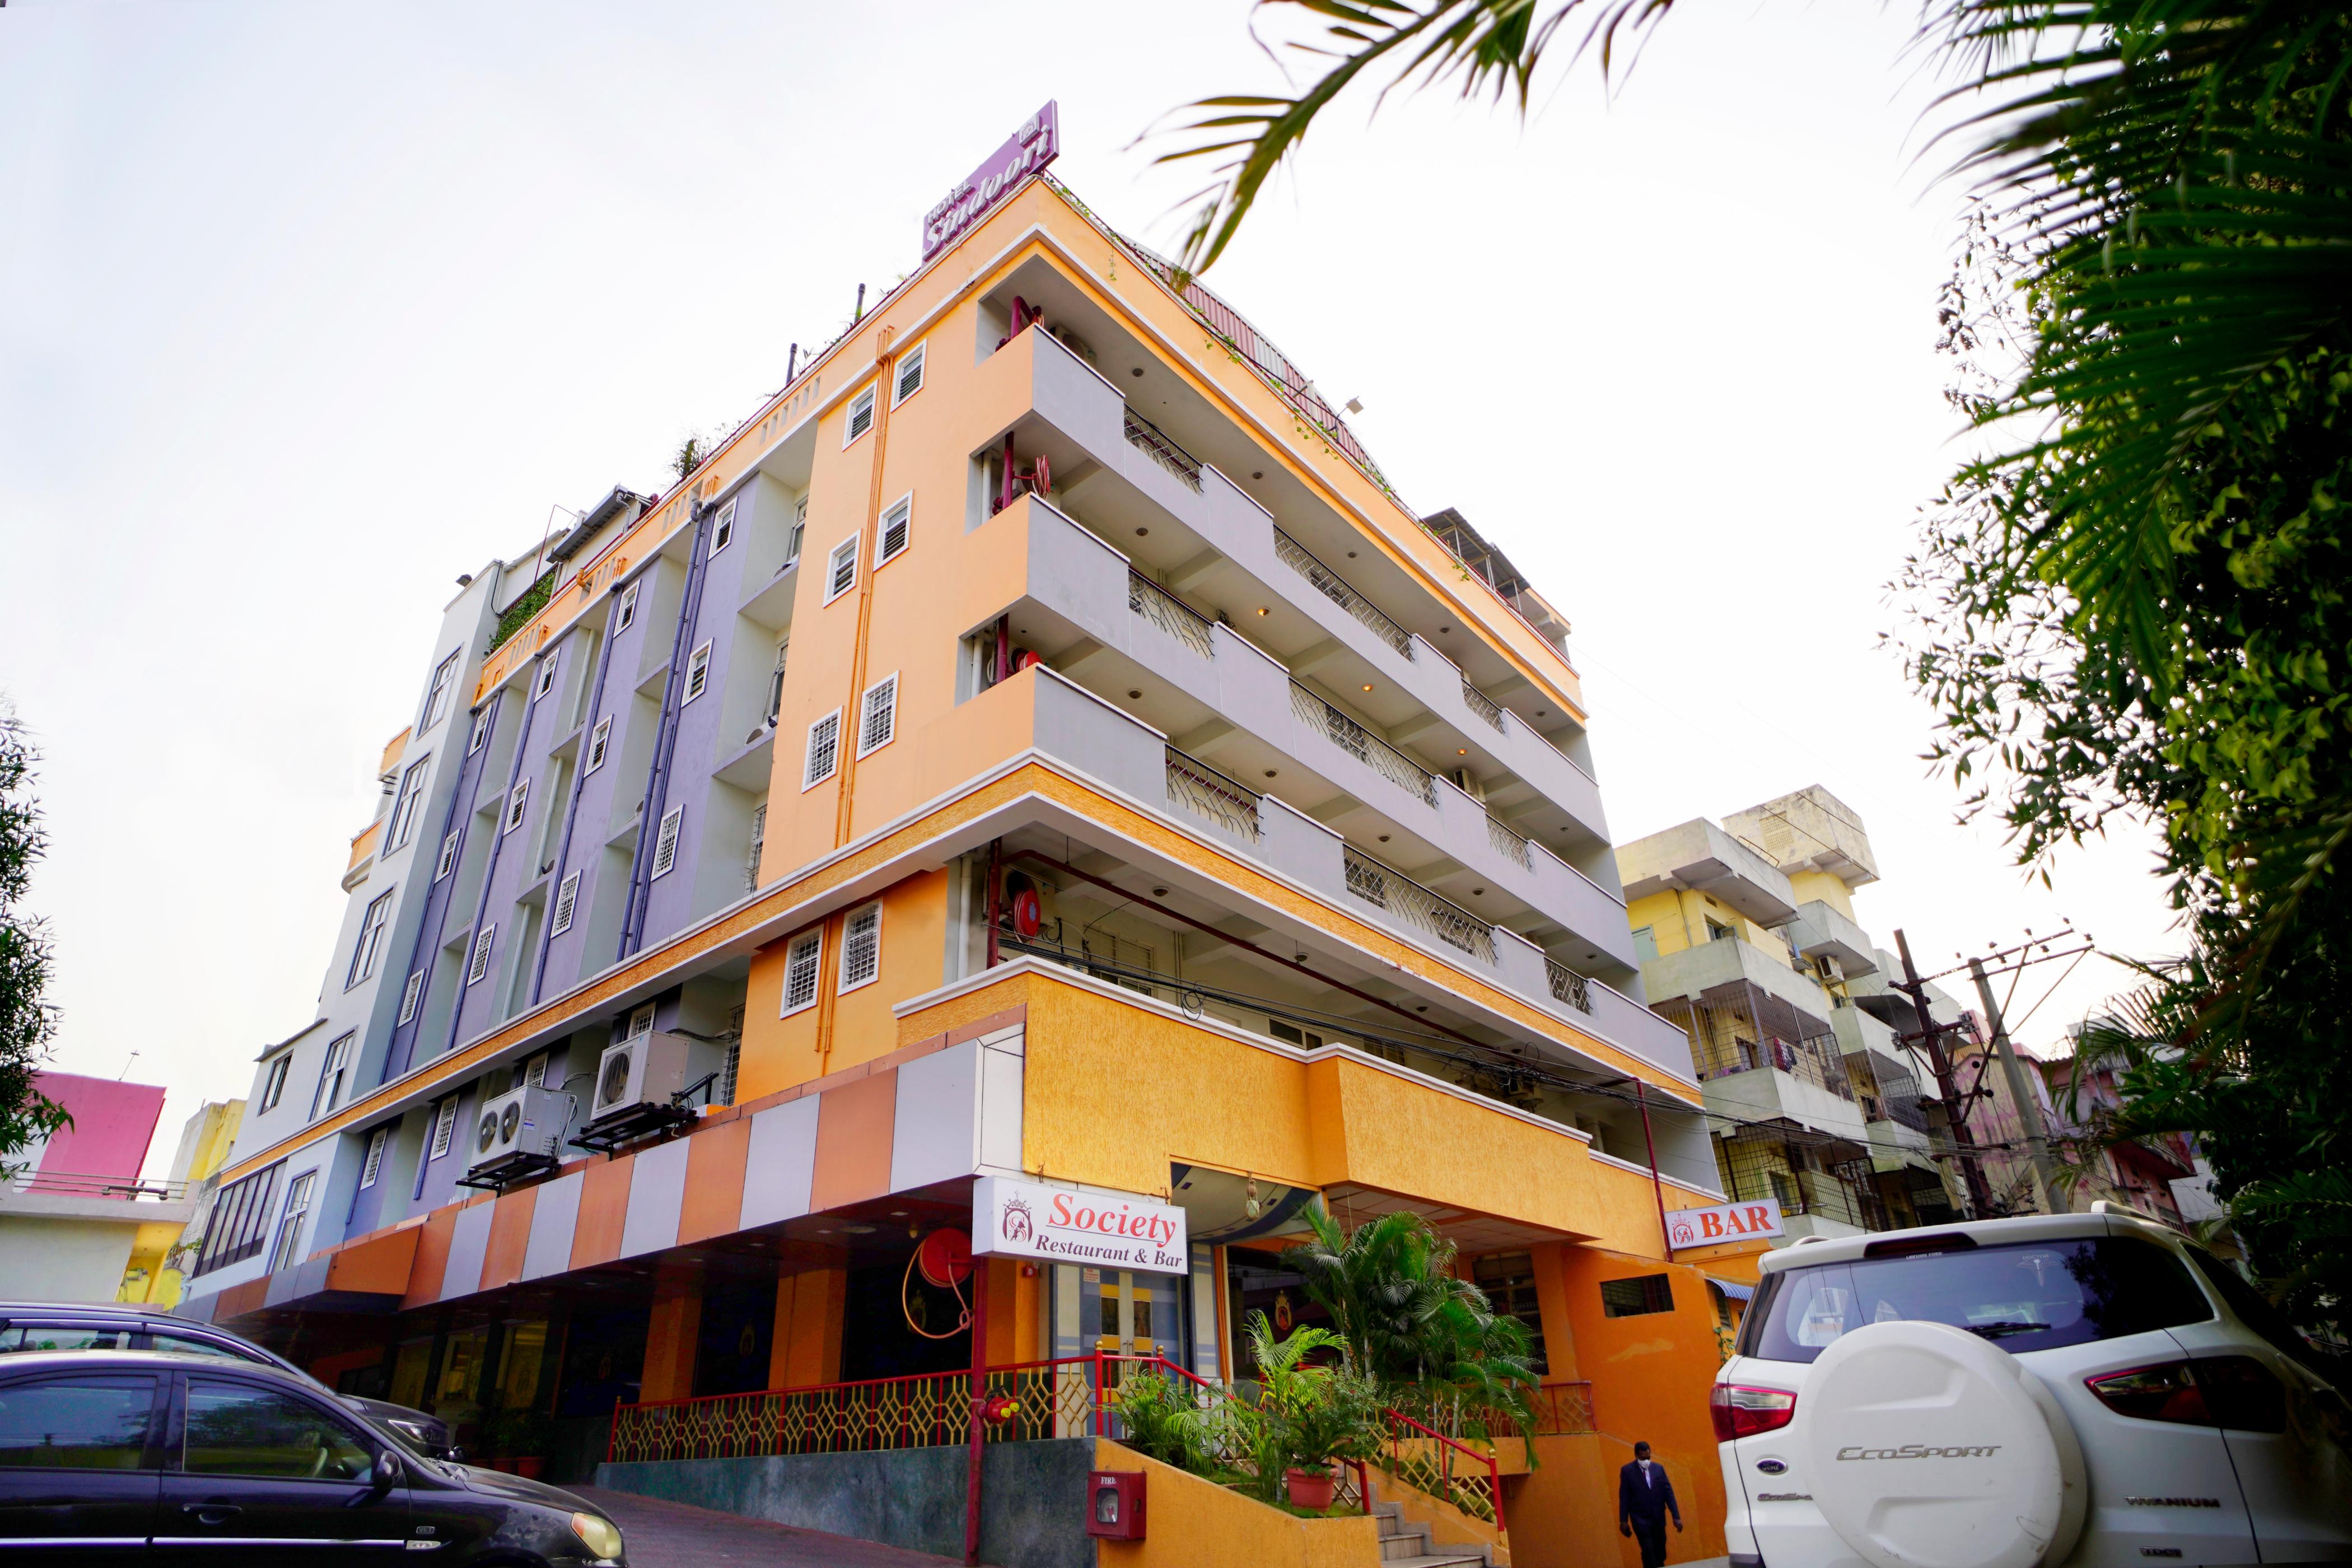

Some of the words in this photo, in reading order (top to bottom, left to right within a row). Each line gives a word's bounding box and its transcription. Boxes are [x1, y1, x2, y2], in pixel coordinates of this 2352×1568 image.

[922, 124, 1051, 262] Sindoori
[927, 181, 975, 225] HOTEL
[1048, 1193, 1176, 1248] Society
[1697, 1206, 1775, 1238] BAR
[1035, 1234, 1130, 1261] Restaurant
[1134, 1248, 1147, 1264] &
[1154, 1249, 1182, 1267] Bar
[2123, 1496, 2221, 1508] TITANIUM
